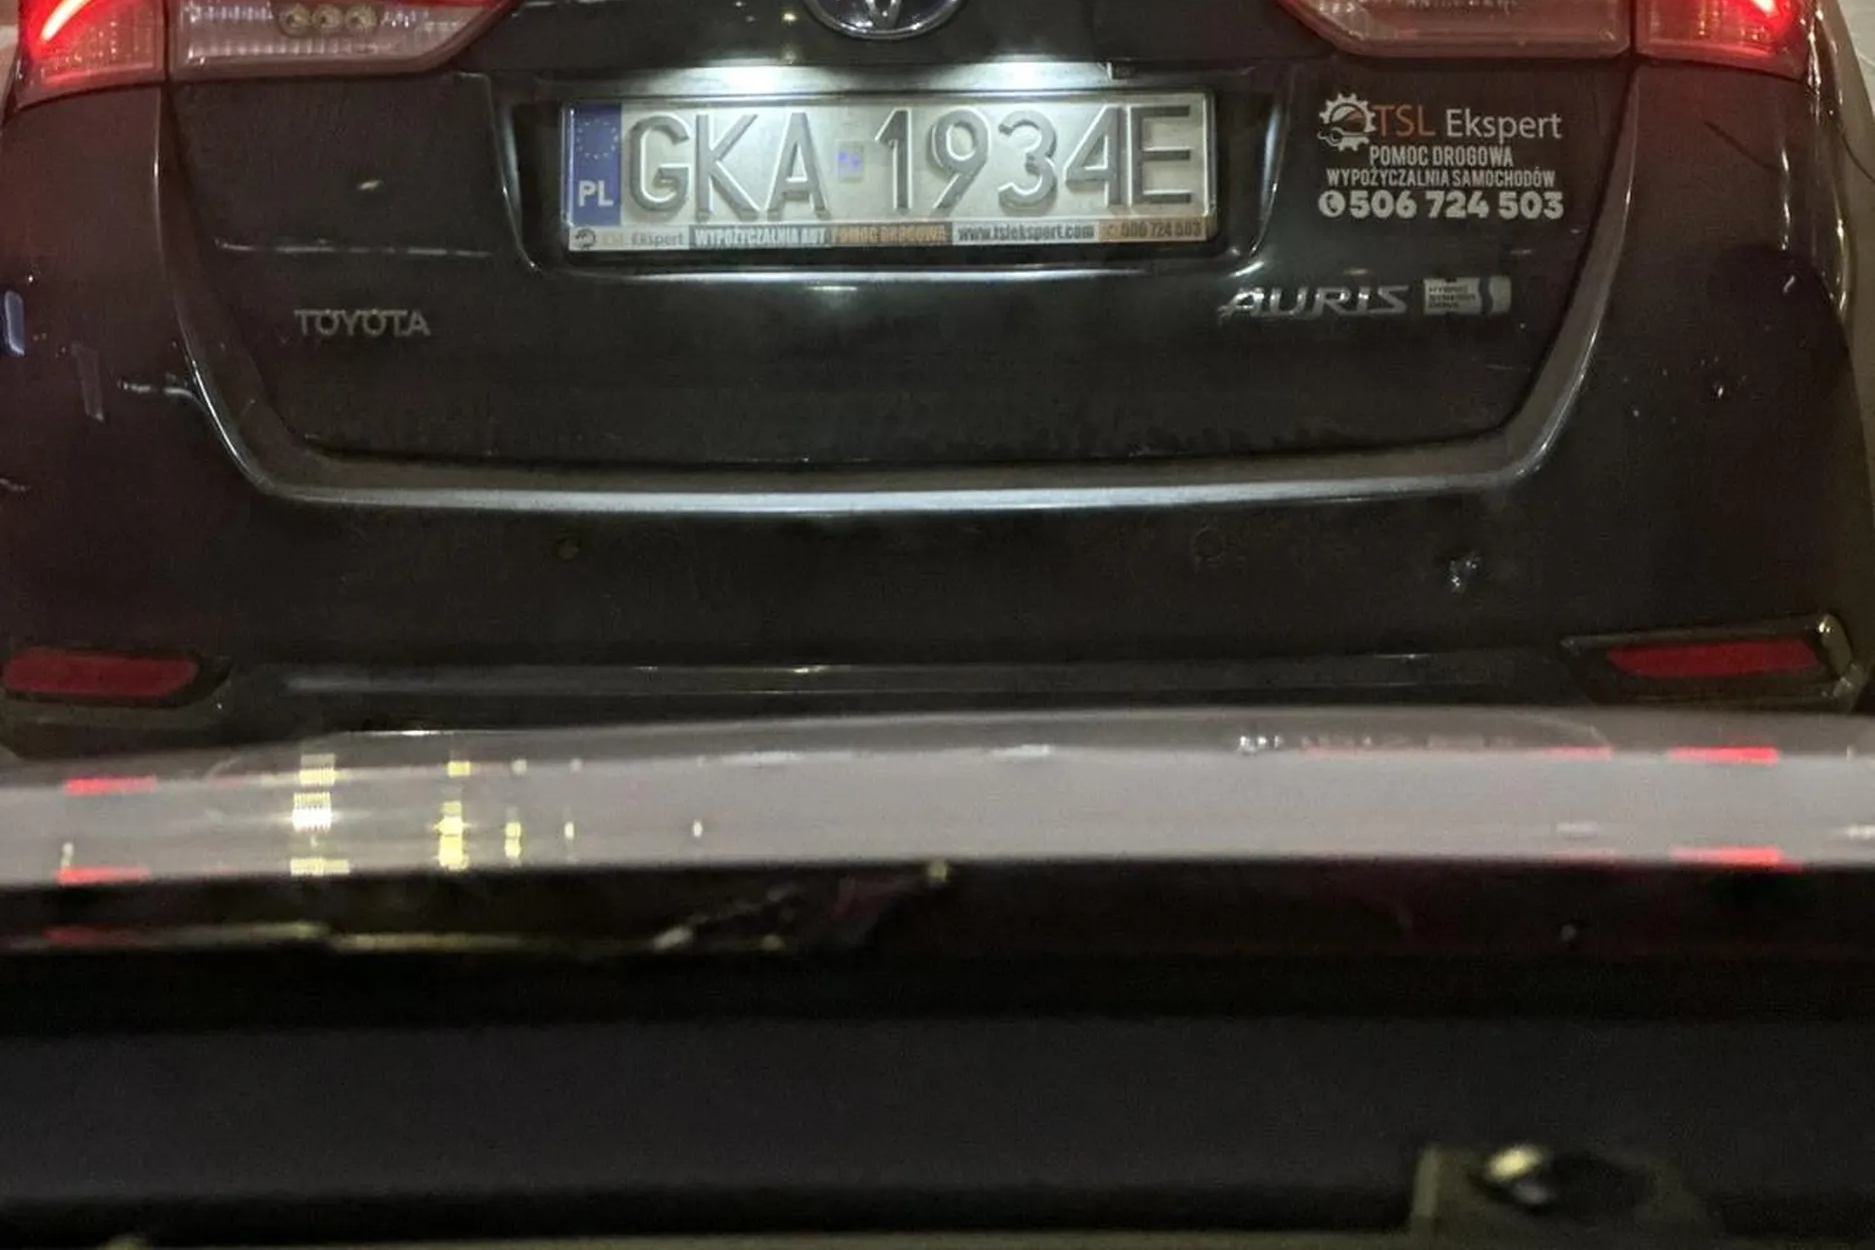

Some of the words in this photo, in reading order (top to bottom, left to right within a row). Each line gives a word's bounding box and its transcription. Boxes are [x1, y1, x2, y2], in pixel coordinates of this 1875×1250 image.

[1374, 104, 1436, 137] TSL
[1446, 108, 1563, 143] Ekspert
[628, 110, 831, 220] GKA
[874, 105, 1194, 216] 1934E
[1369, 145, 1429, 166] POMOC
[1432, 145, 1514, 167] DROGOWA
[1326, 166, 1449, 187] WYPOŻYCZALNIA
[1452, 166, 1556, 187] SAMOCHODÓW
[578, 181, 614, 207] PL
[1350, 189, 1417, 219] 506
[1425, 190, 1490, 219] 724
[1498, 190, 1564, 220] 503
[631, 230, 684, 247] Ekspert
[1217, 285, 1410, 321] AURIS
[293, 308, 432, 338] TOYOTA
